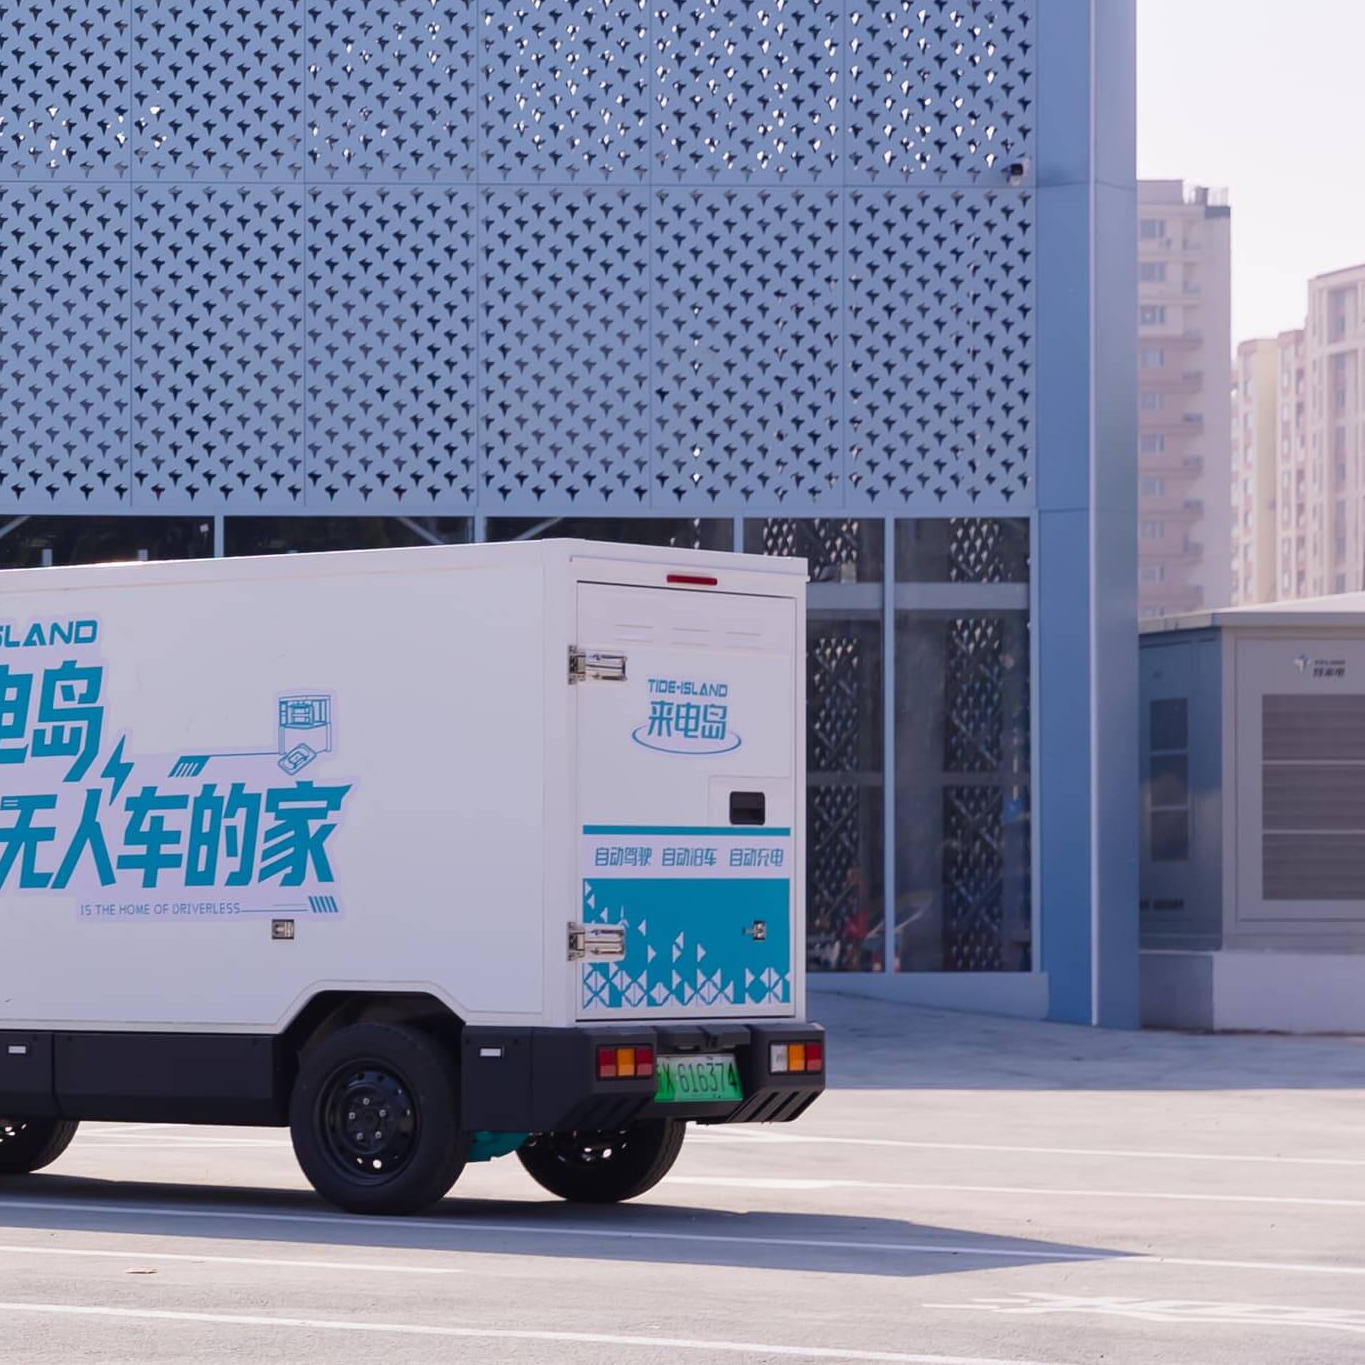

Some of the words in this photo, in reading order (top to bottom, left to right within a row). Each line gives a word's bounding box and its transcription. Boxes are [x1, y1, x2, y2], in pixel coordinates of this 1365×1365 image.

[647, 679, 728, 697] TIDE-ISLAND
[647, 700, 728, 740] 来电岛
[595, 846, 652, 866] 自动驾驶
[661, 847, 717, 866] 自动泊车
[729, 847, 784, 866] 自动充电
[80, 904, 92, 916] IS
[96, 904, 116, 916] THE
[119, 904, 150, 915] HOME
[153, 903, 169, 915] OF
[172, 902, 241, 915] DRIVERLESS
